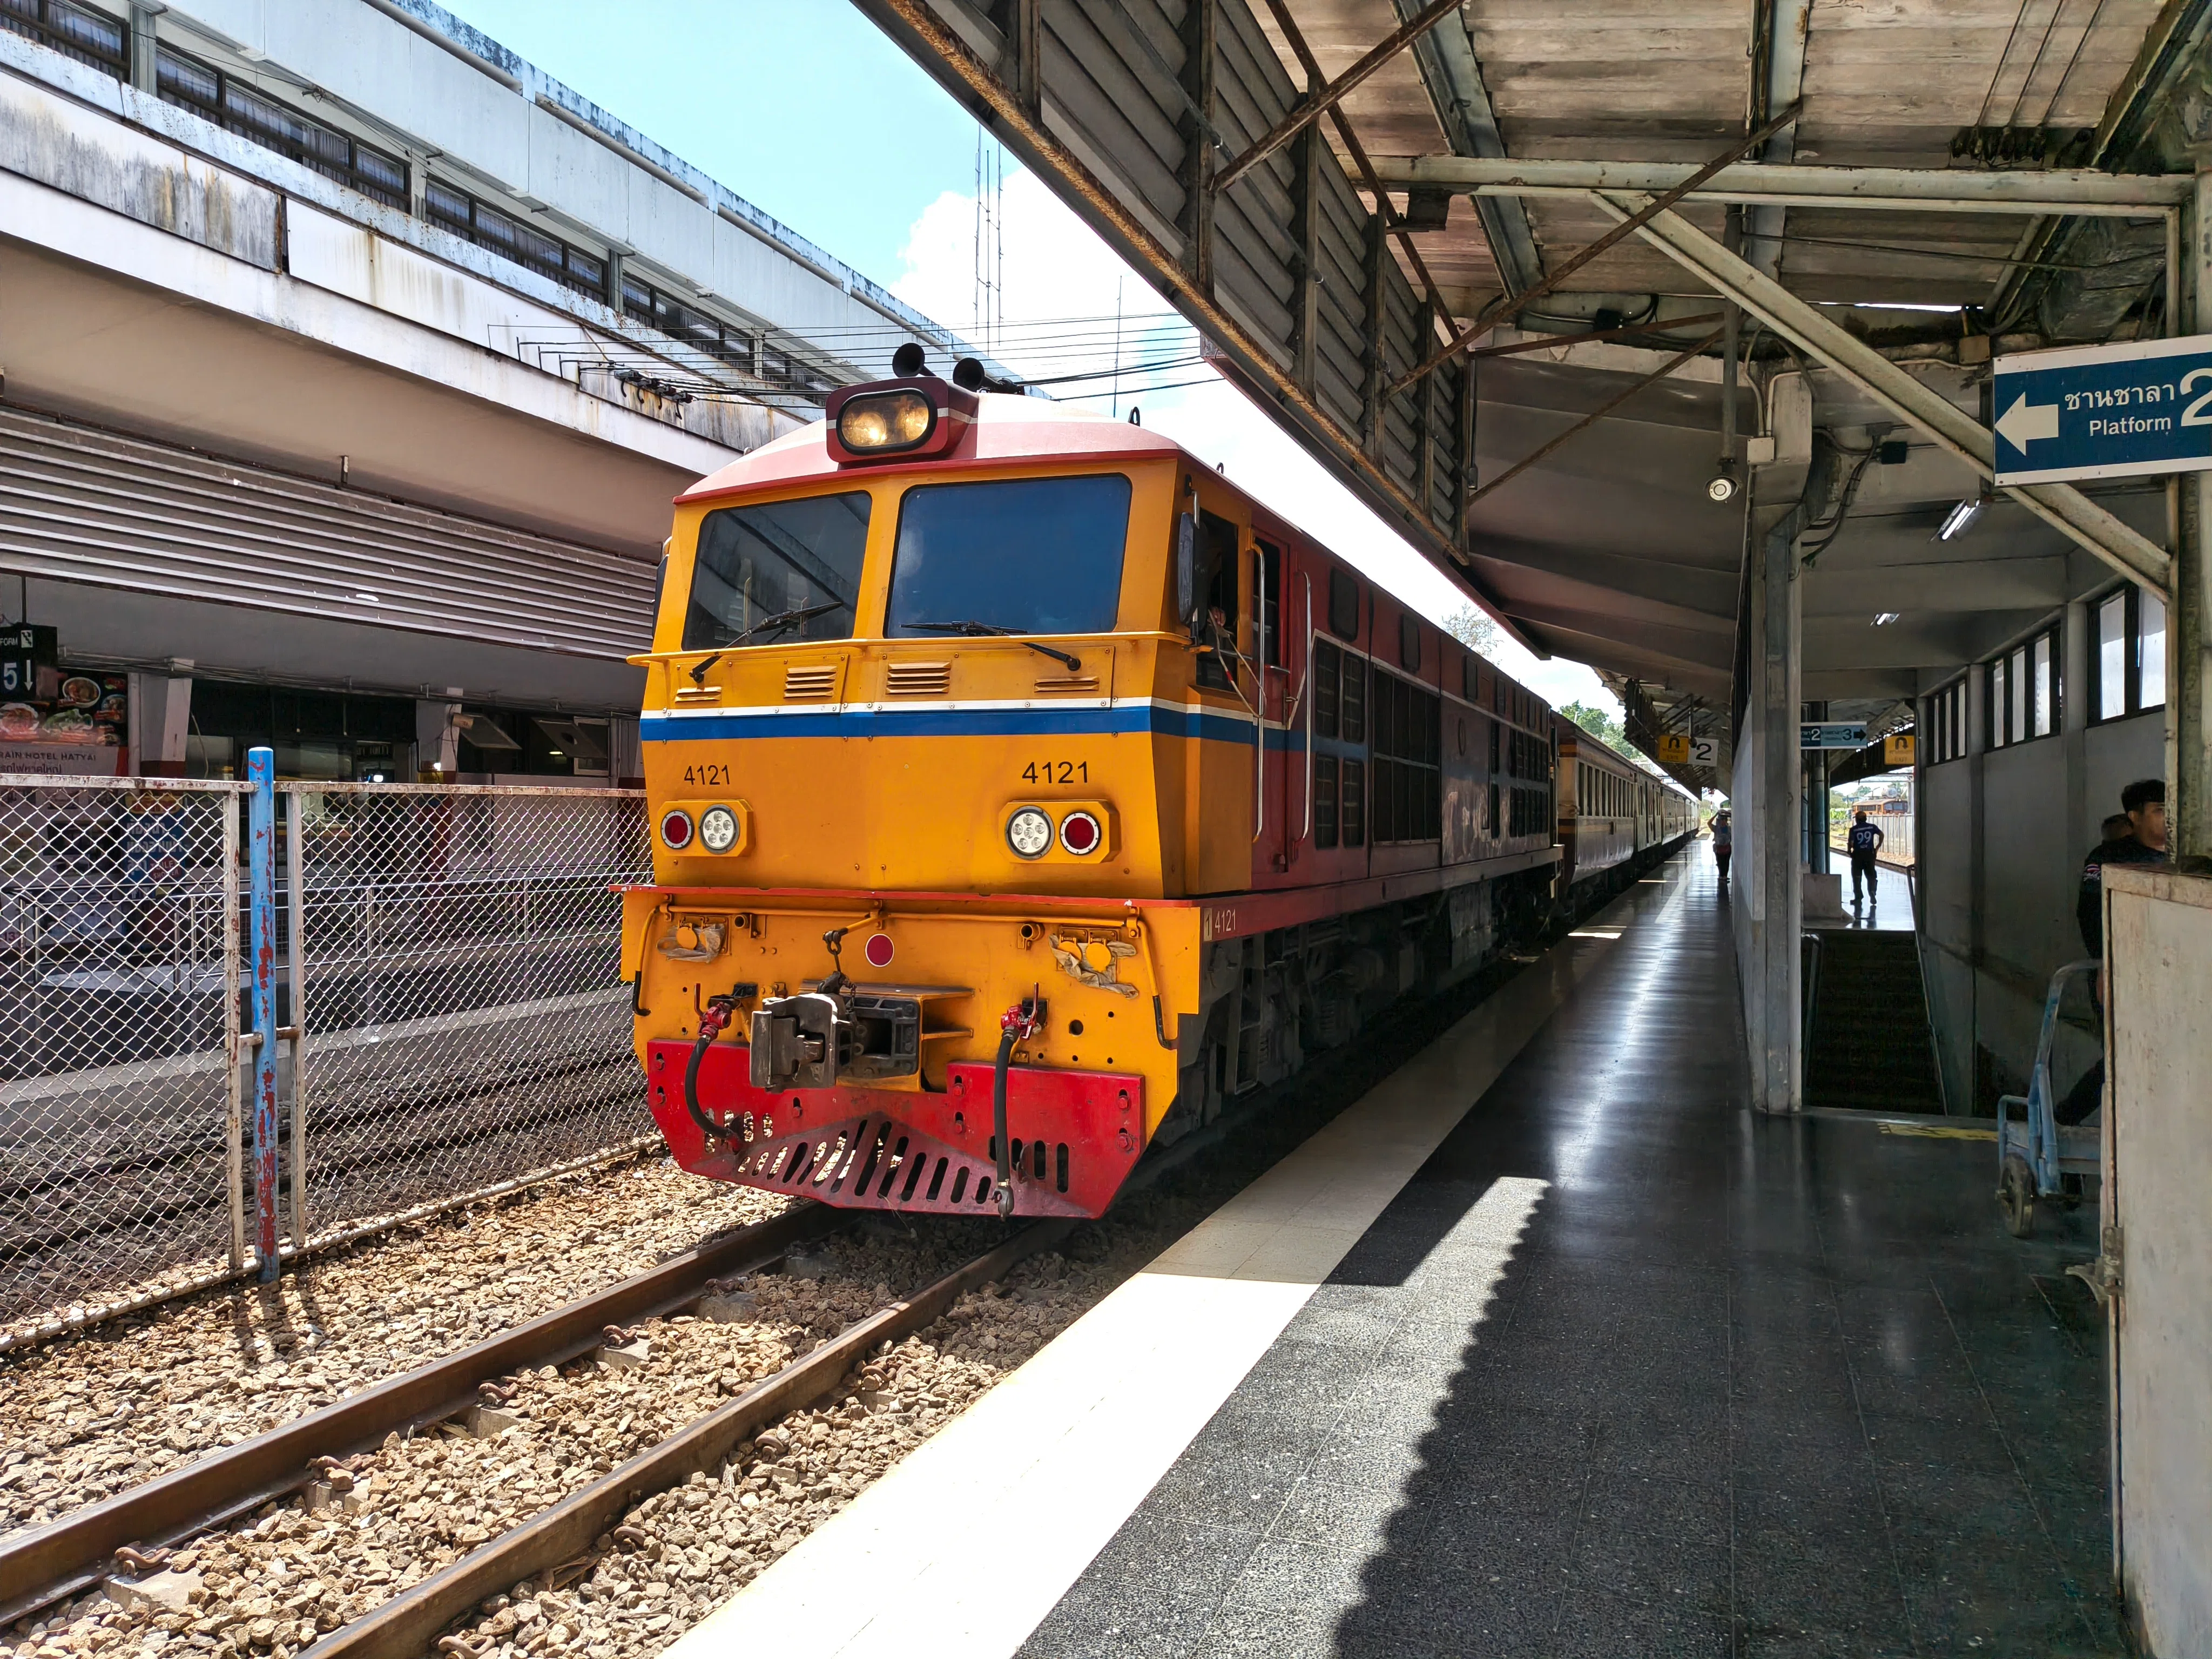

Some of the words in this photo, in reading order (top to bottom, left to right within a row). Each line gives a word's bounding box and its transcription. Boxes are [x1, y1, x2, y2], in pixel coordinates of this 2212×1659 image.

[2065, 384, 2174, 410] ชานชาลา
[2180, 368, 2212, 427] 2
[2089, 416, 2171, 436] Platform
[4, 662, 17, 691] 5
[1811, 729, 1820, 741] 2
[1842, 729, 1852, 741] 3
[25, 752, 58, 760] HOTEL
[61, 751, 96, 761] HATYAI
[1696, 743, 1712, 761] 2
[684, 764, 730, 785] 4121
[1022, 761, 1088, 784] 4121
[1856, 831, 1872, 844] 99
[1205, 914, 1210, 936] 1
[1215, 908, 1236, 934] 4121
